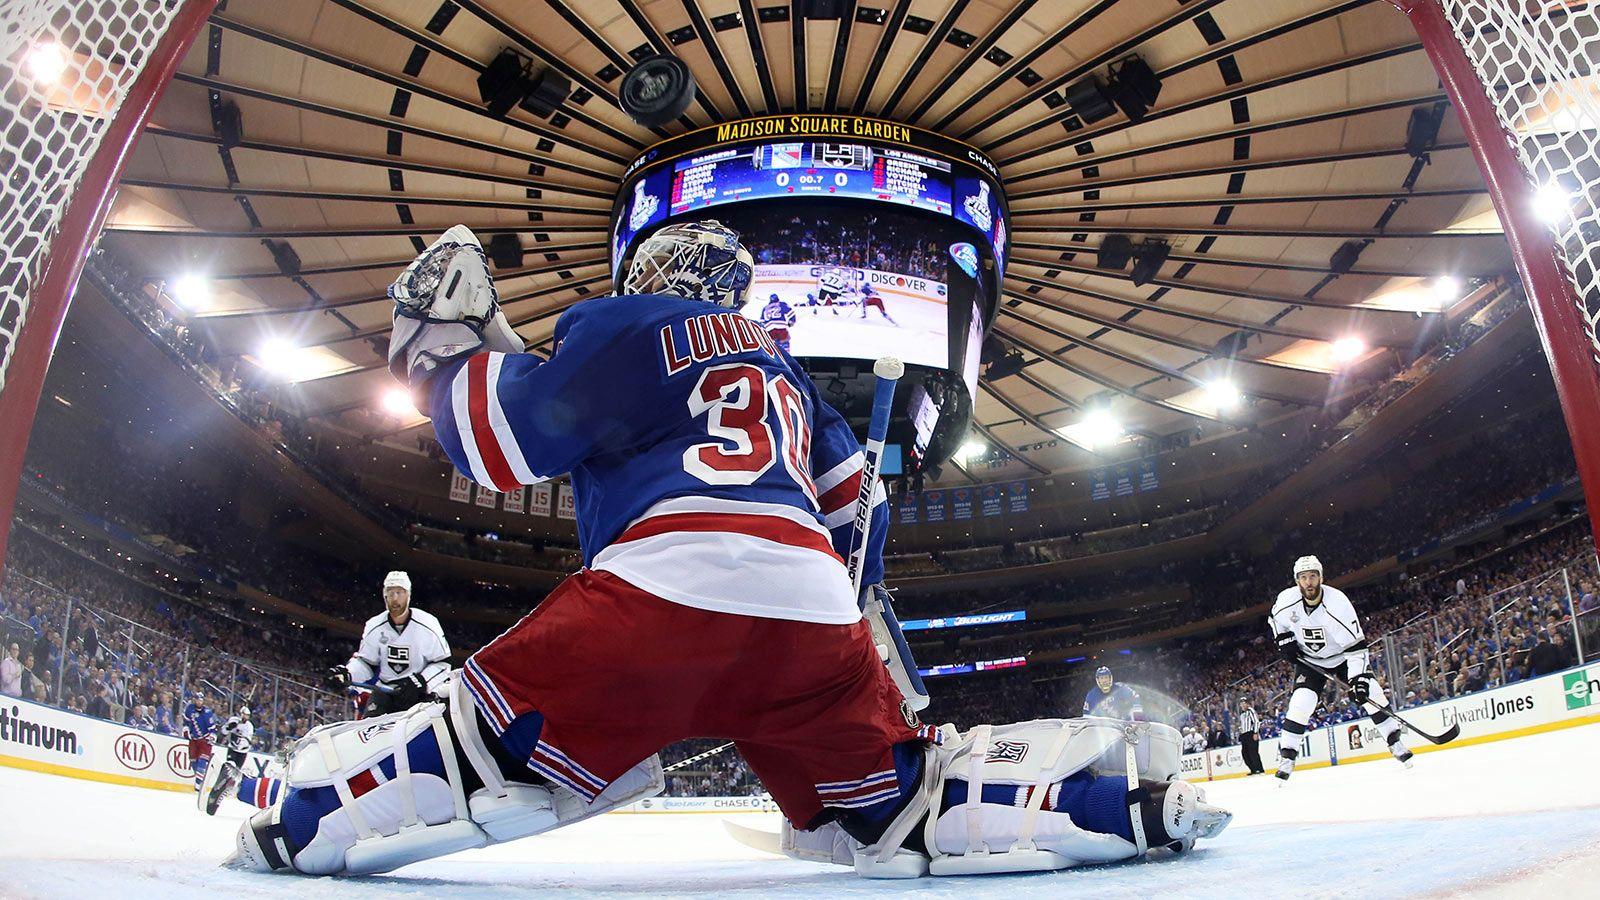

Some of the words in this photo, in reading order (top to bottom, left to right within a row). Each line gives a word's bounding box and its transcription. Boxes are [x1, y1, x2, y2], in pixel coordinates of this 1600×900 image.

[717, 120, 785, 142] MADISON
[789, 116, 848, 133] SQUARE
[854, 118, 910, 143] GARDEN
[776, 172, 790, 187] 0
[799, 175, 824, 184] 00.7
[834, 172, 848, 187] 0
[871, 273, 927, 291] DISCOVER
[682, 362, 820, 513] 30
[455, 476, 468, 491] 10
[535, 491, 548, 505] 15
[855, 460, 876, 534] BAUER
[982, 613, 1015, 623] LIGHT
[1303, 629, 1324, 639] LA
[388, 647, 409, 659] LA
[1441, 699, 1489, 728] Edward
[1490, 695, 1534, 721] Jones
[122, 739, 149, 764] KIA
[173, 750, 192, 770] KI
[714, 799, 749, 808] CHASE
